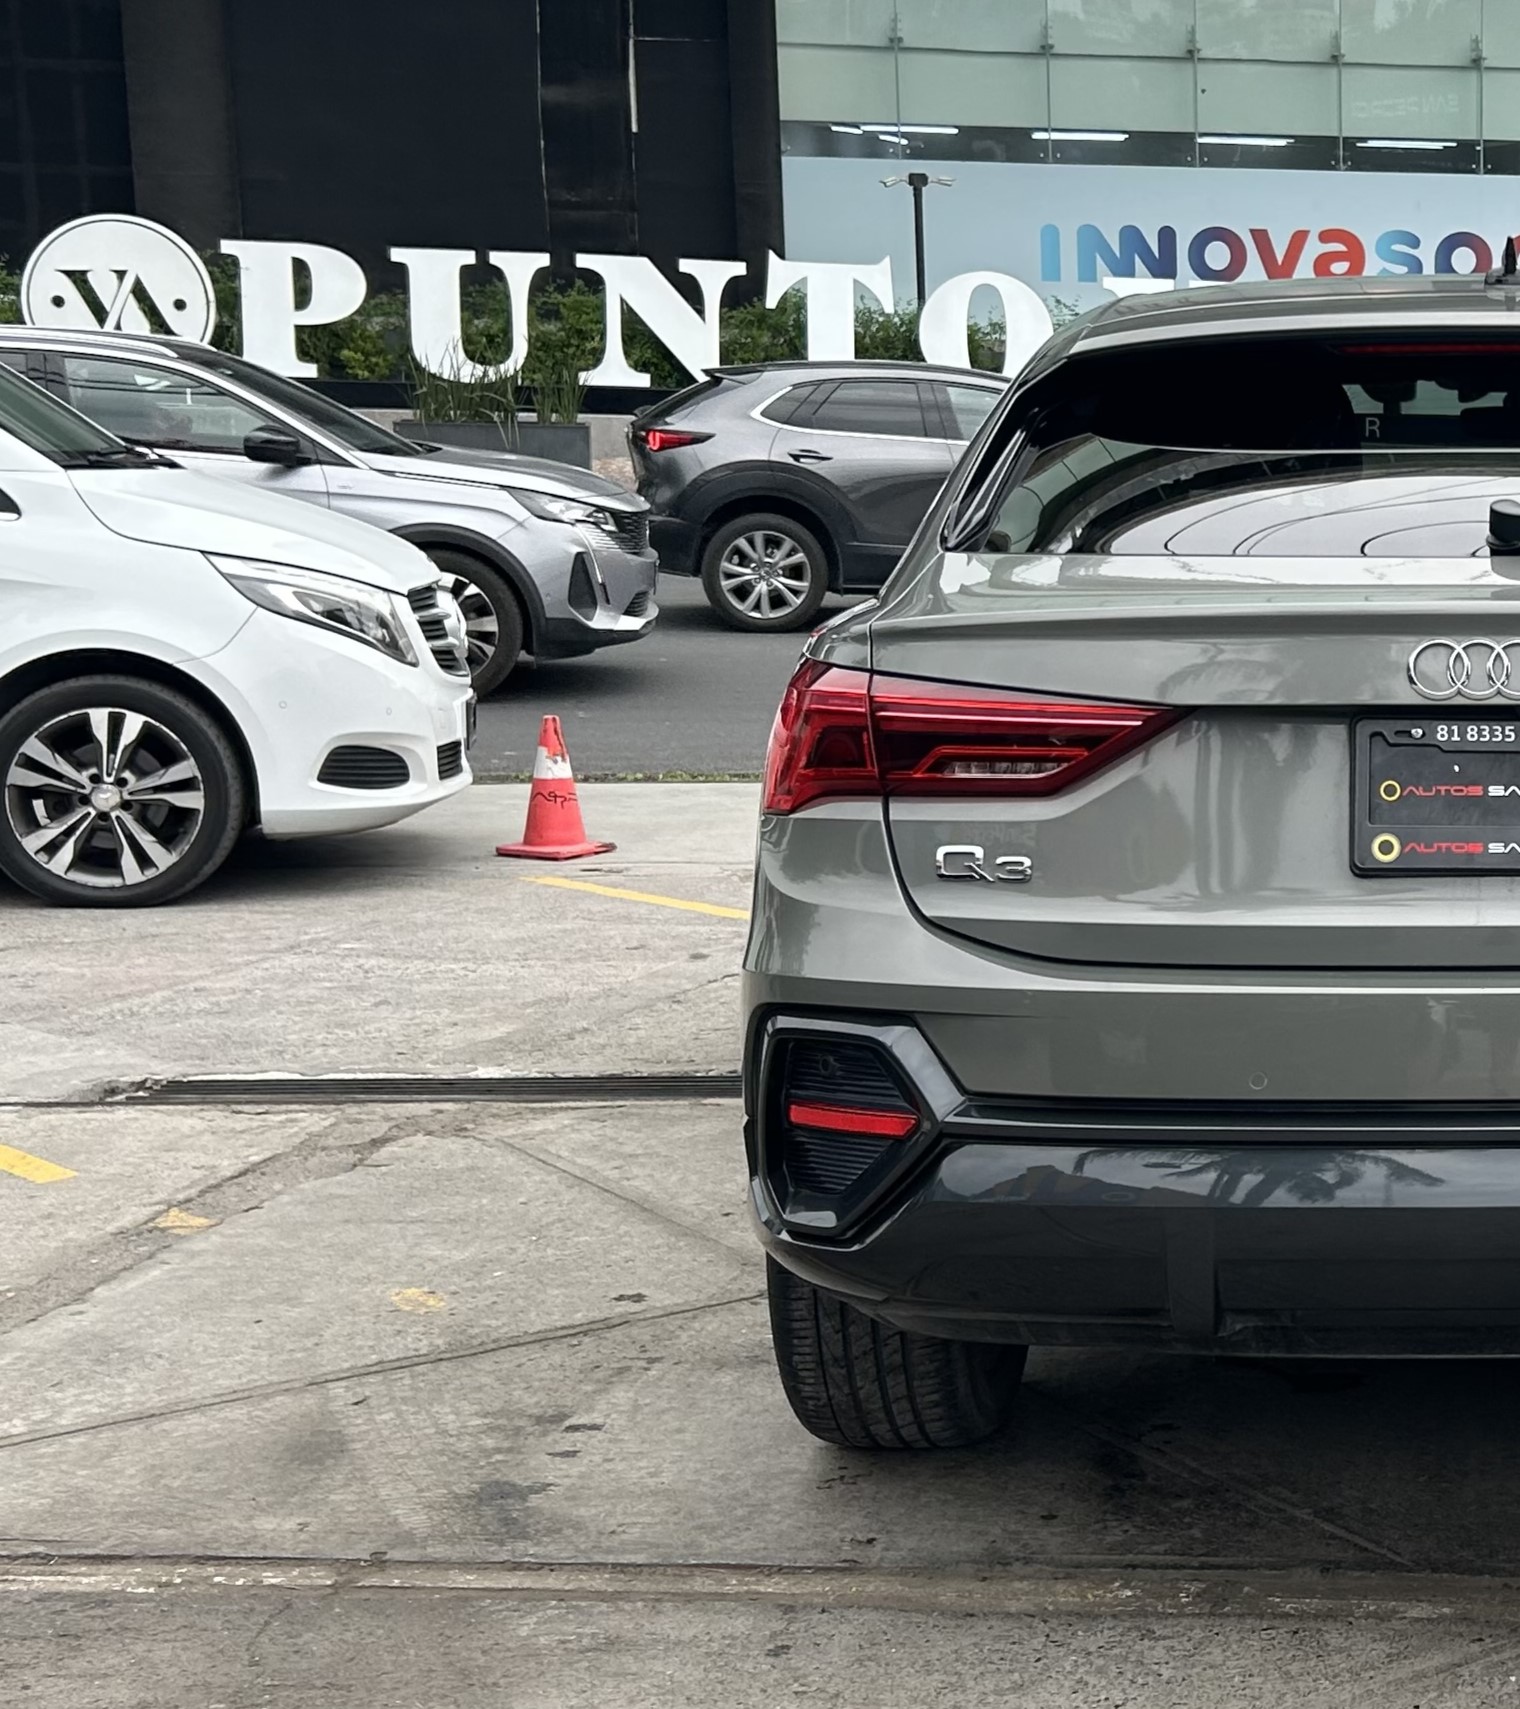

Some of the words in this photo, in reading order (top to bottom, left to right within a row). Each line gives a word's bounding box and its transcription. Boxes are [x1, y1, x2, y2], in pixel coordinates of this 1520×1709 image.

[220, 238, 1055, 389] PUNTO
[1436, 725, 1460, 742] 81
[1466, 725, 1515, 742] 8335
[1402, 785, 1484, 797] AUTOS
[1403, 842, 1484, 854] AUTOS
[936, 844, 1033, 882] Q3
